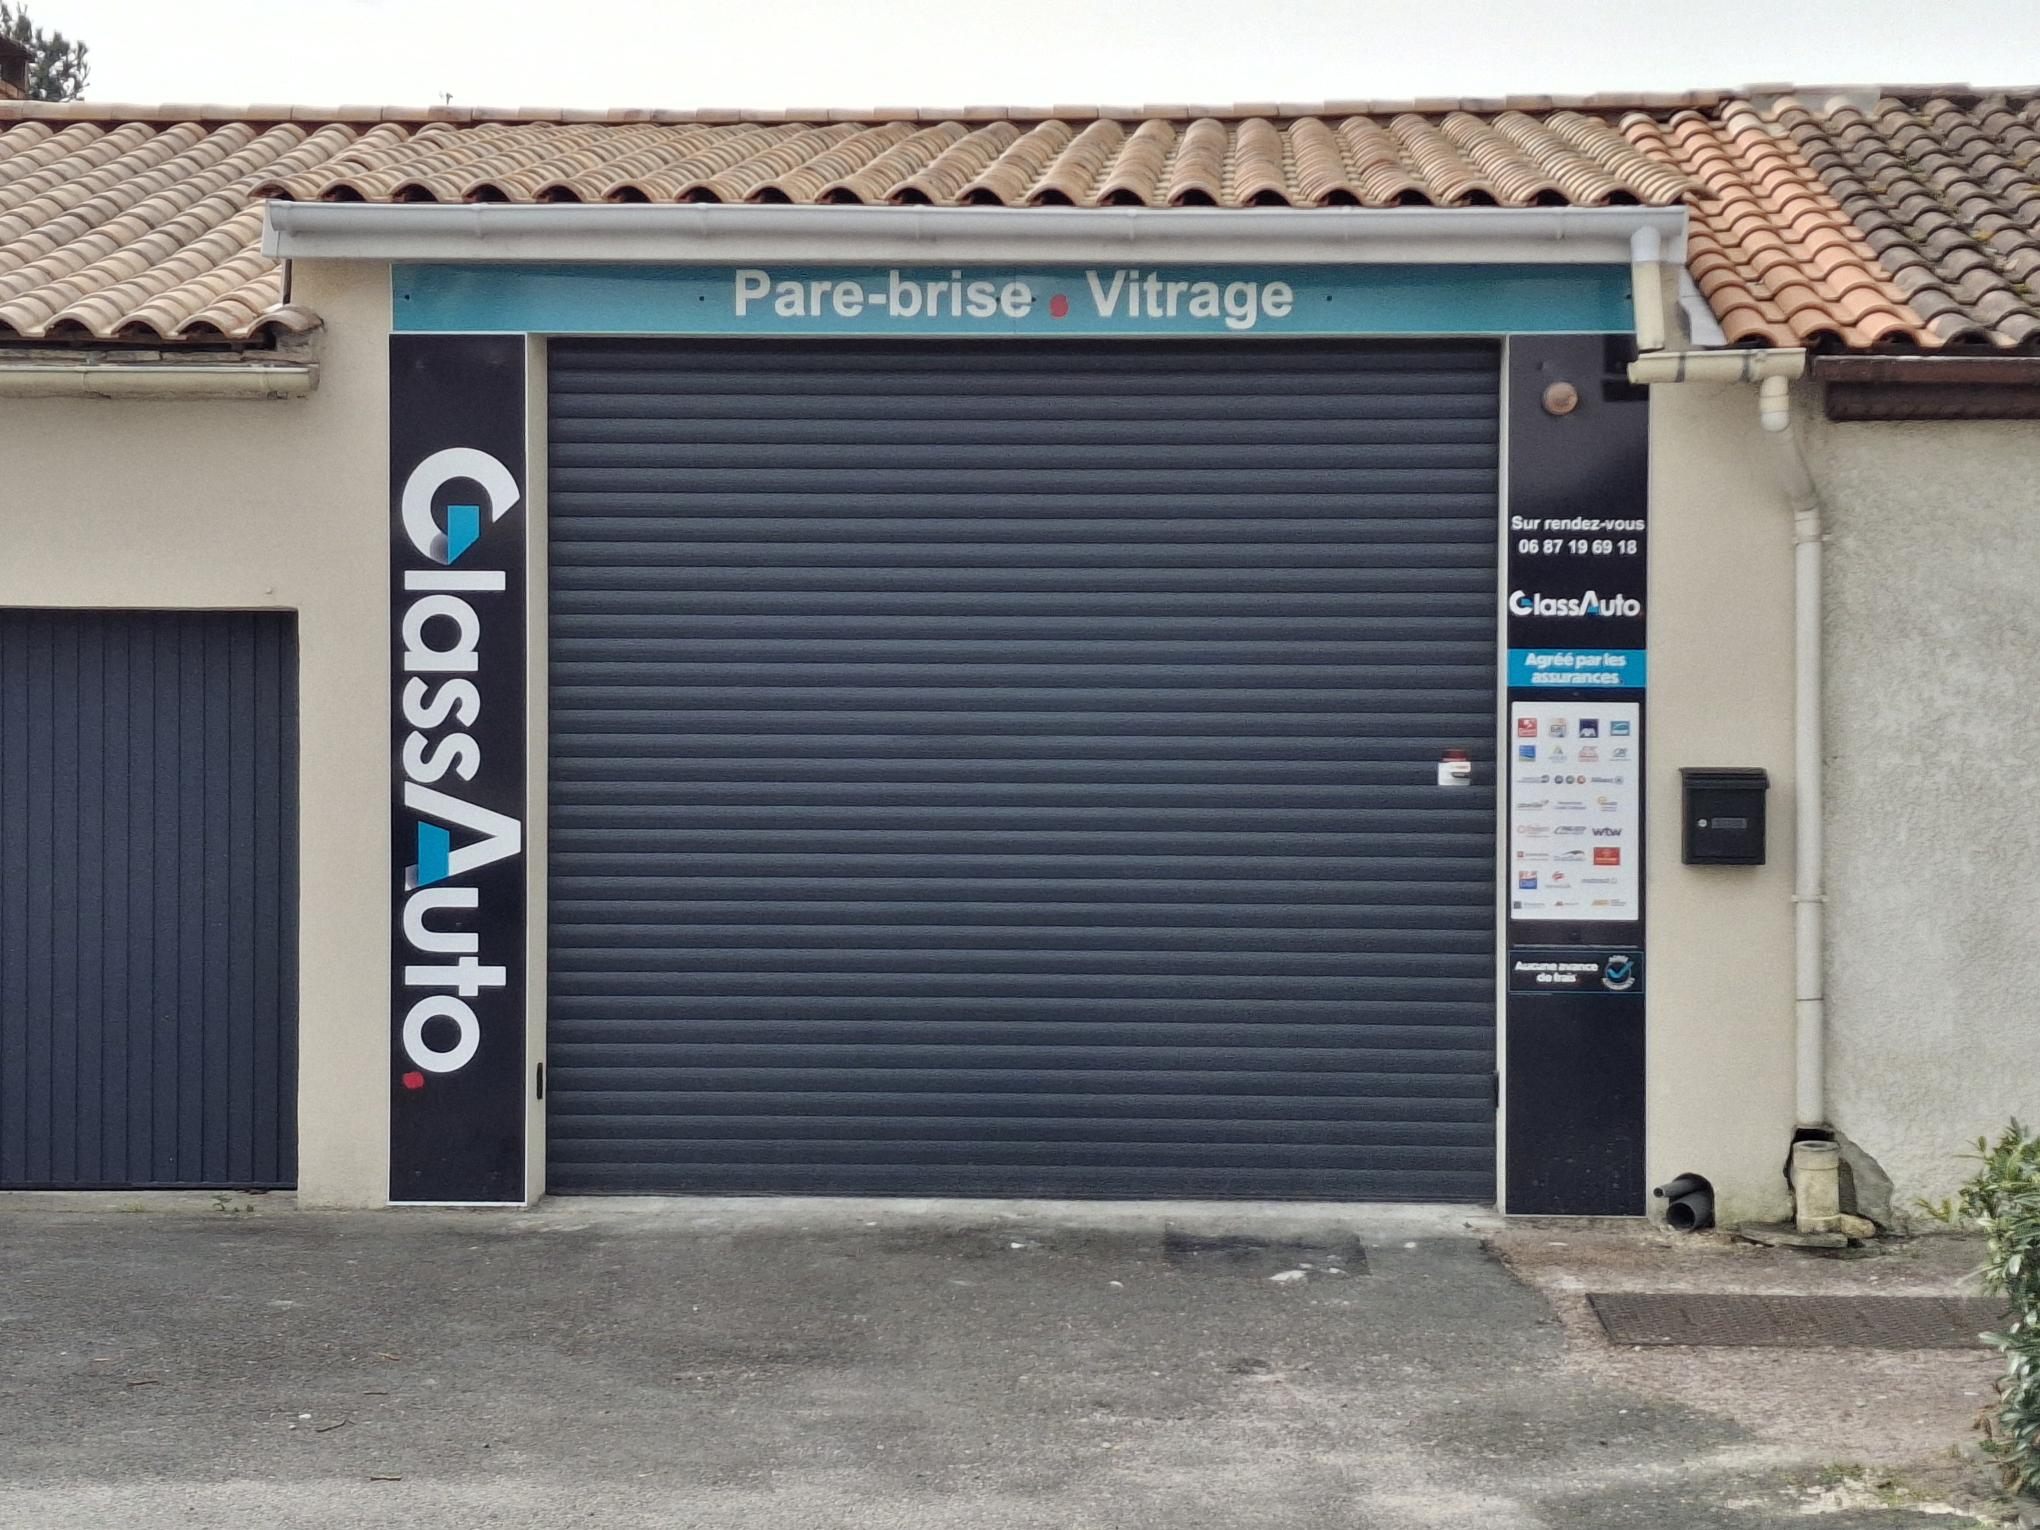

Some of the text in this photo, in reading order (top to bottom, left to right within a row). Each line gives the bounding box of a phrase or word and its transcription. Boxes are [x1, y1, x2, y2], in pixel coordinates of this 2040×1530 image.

[734, 269, 1294, 330] Pare-brise Vitrage
[1511, 515, 1646, 531] Sur rendez-vous
[1518, 539, 1637, 555] 06 87 19 69 18
[1525, 652, 1627, 668] Agréé par les
